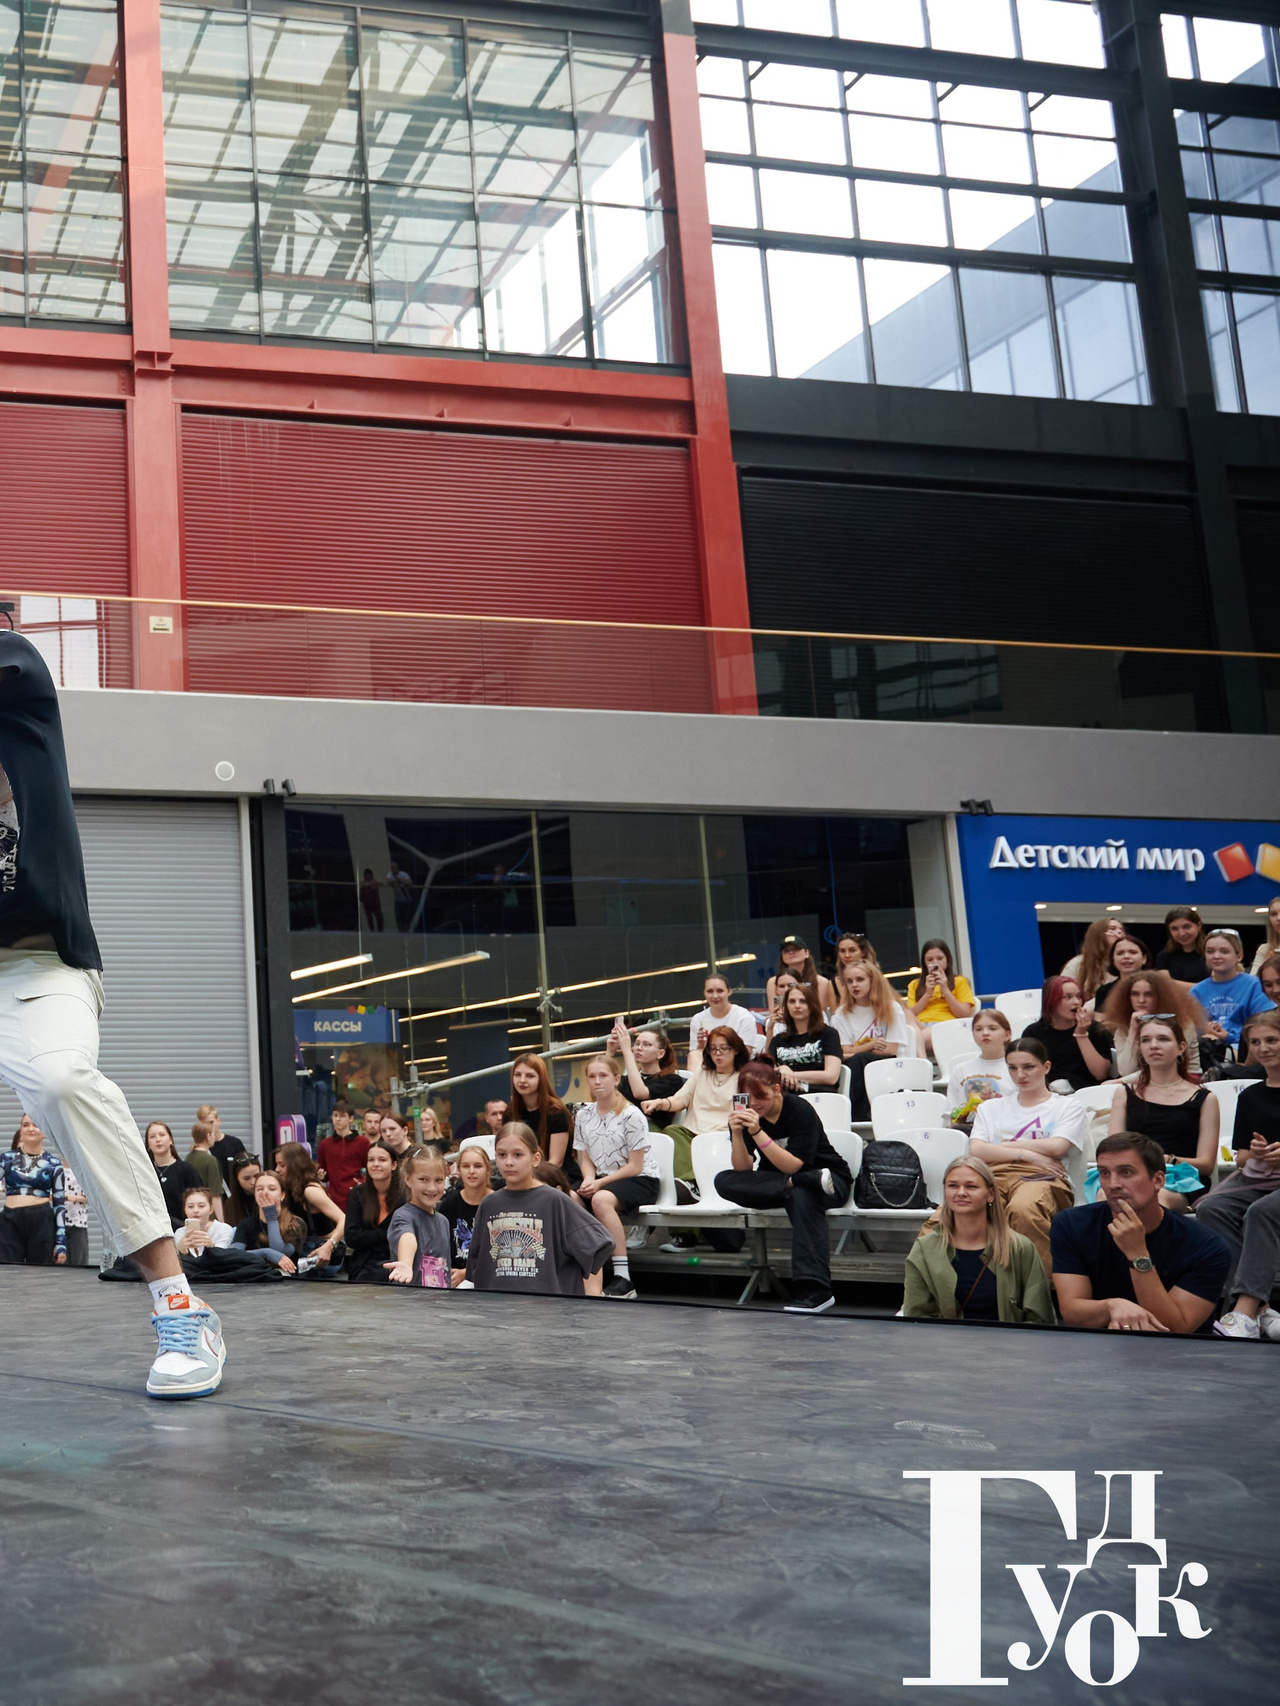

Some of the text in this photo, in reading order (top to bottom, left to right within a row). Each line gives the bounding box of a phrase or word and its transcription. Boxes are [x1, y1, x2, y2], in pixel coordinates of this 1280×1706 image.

[989, 836, 1205, 881] Детский мир
[313, 1021, 362, 1032] КАССЫ
